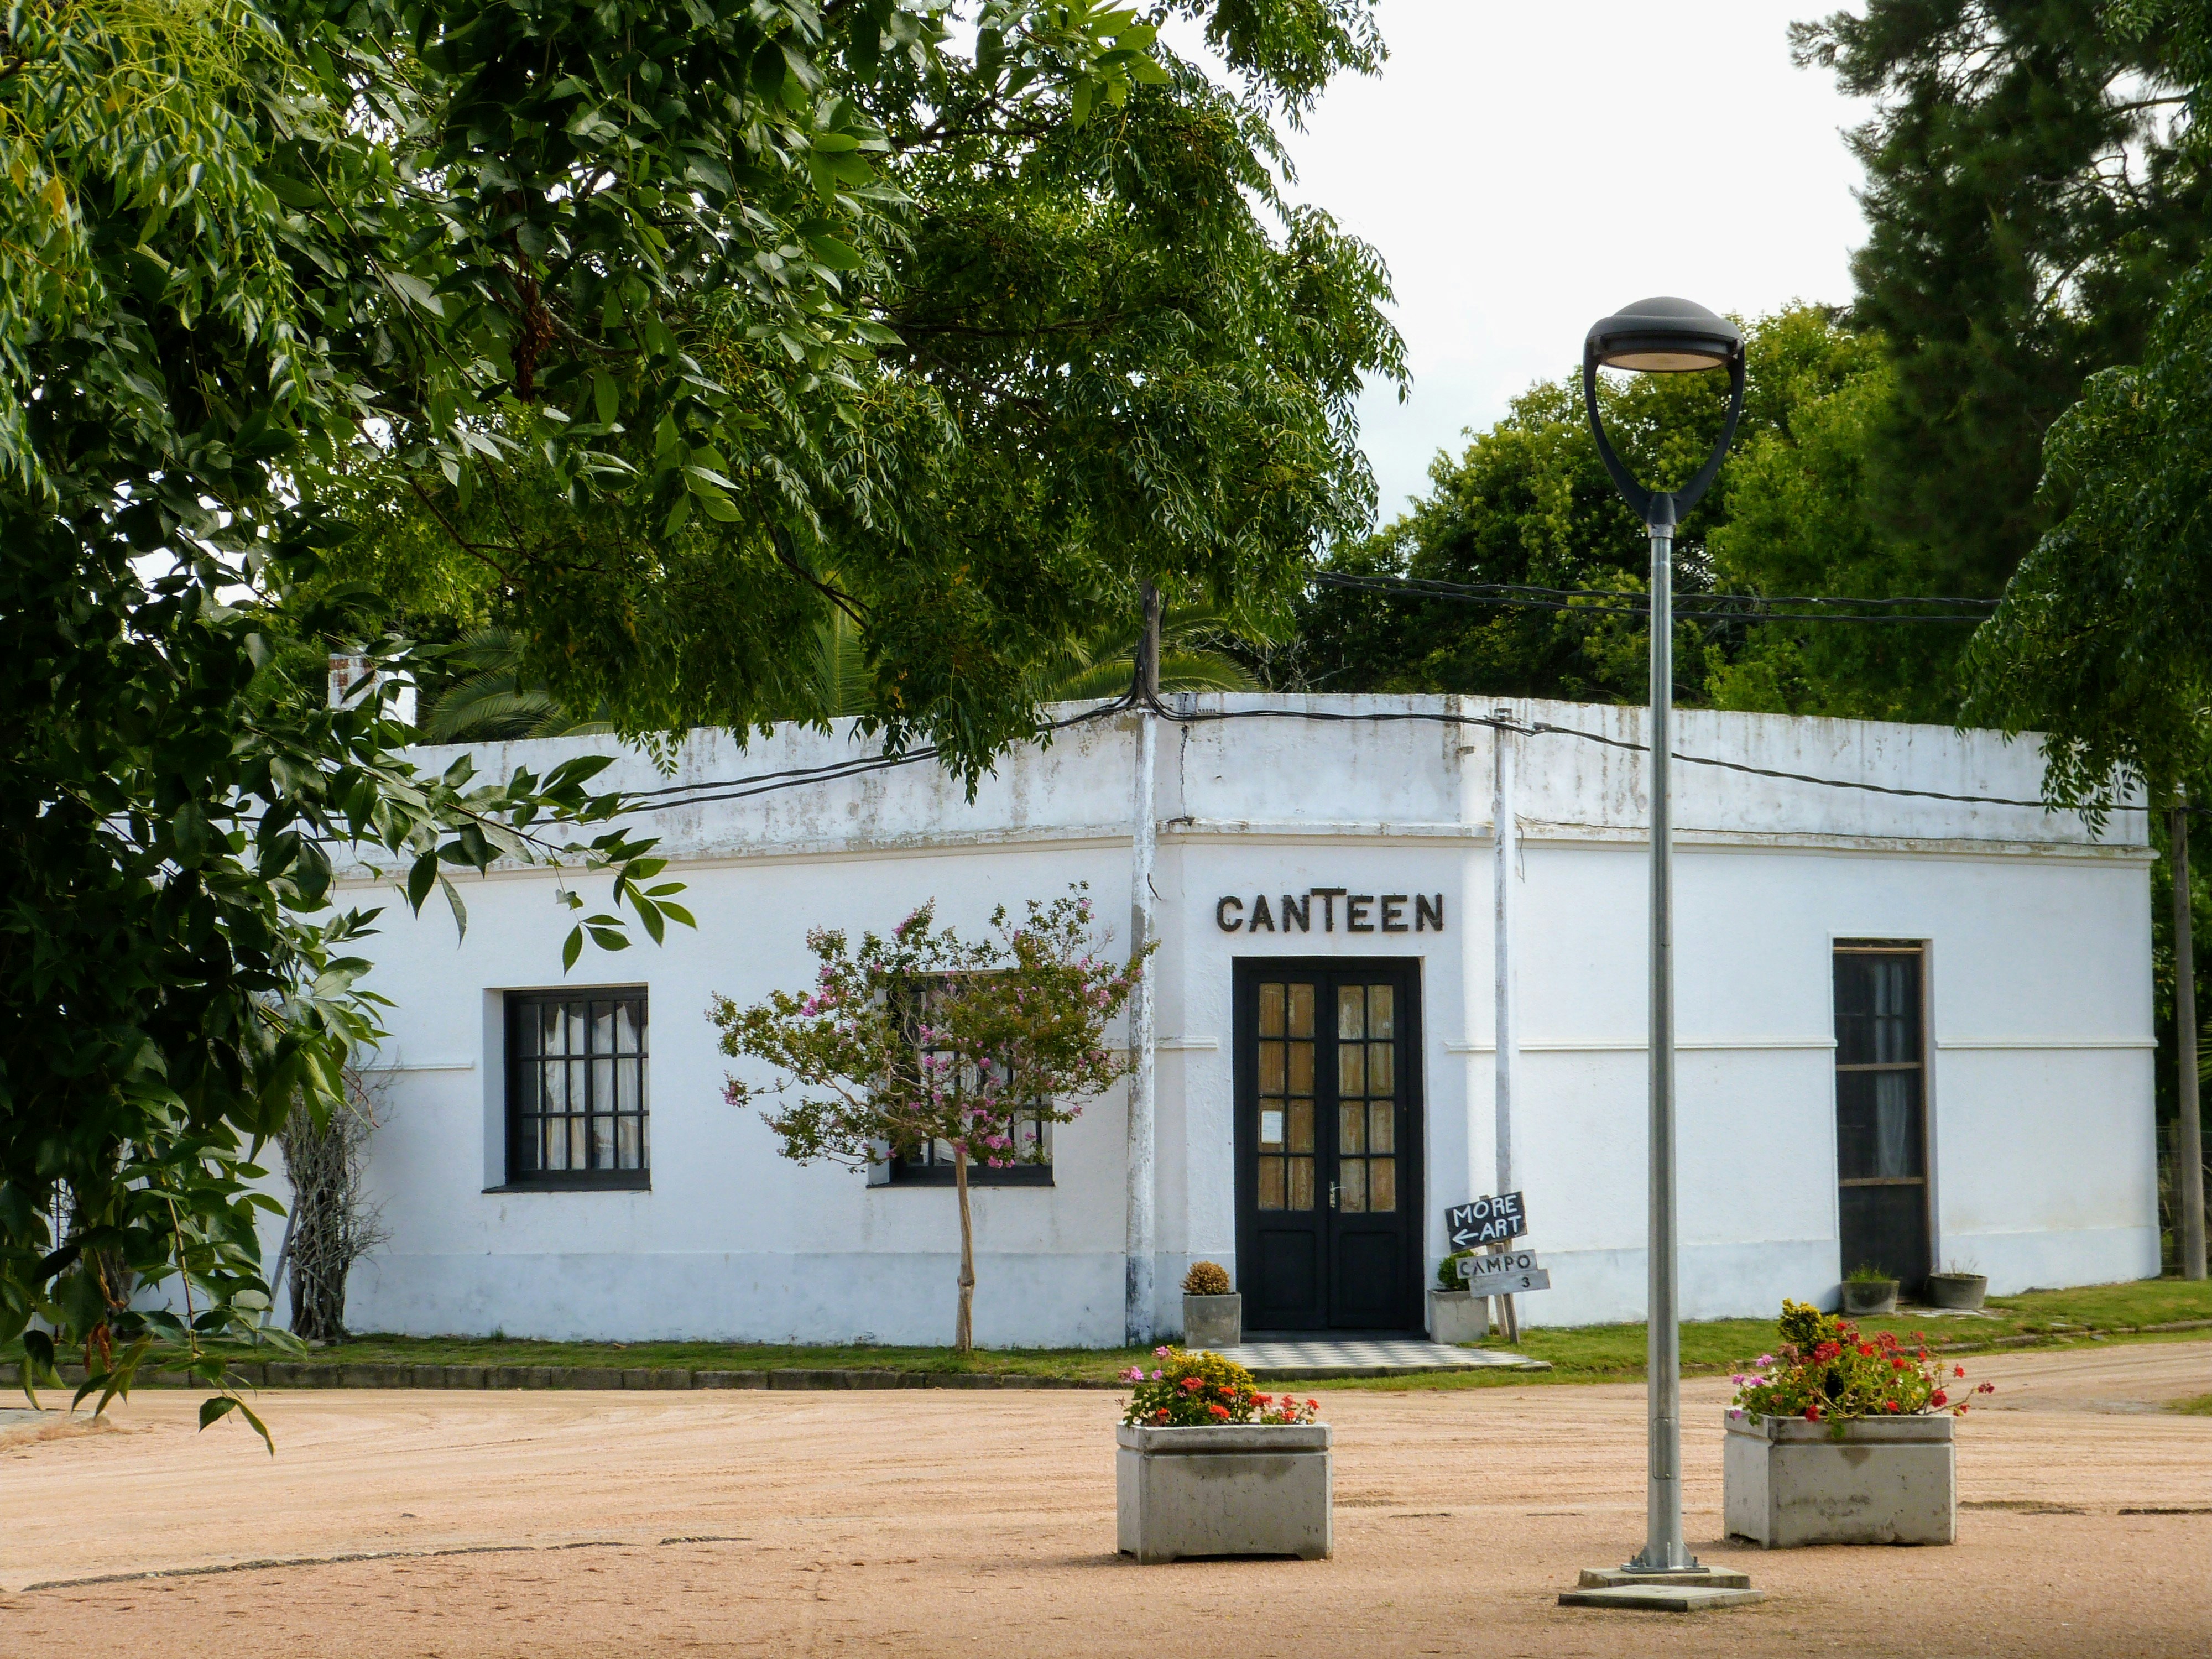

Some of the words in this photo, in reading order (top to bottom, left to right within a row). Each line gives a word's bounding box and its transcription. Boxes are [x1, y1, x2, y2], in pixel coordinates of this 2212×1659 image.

[1217, 888, 1443, 932] CANTEEN
[1453, 1194, 1517, 1227] MORE
[1479, 1215, 1521, 1241] ART
[1460, 1254, 1531, 1276] CAMPO
[1521, 1277, 1531, 1288] 3
